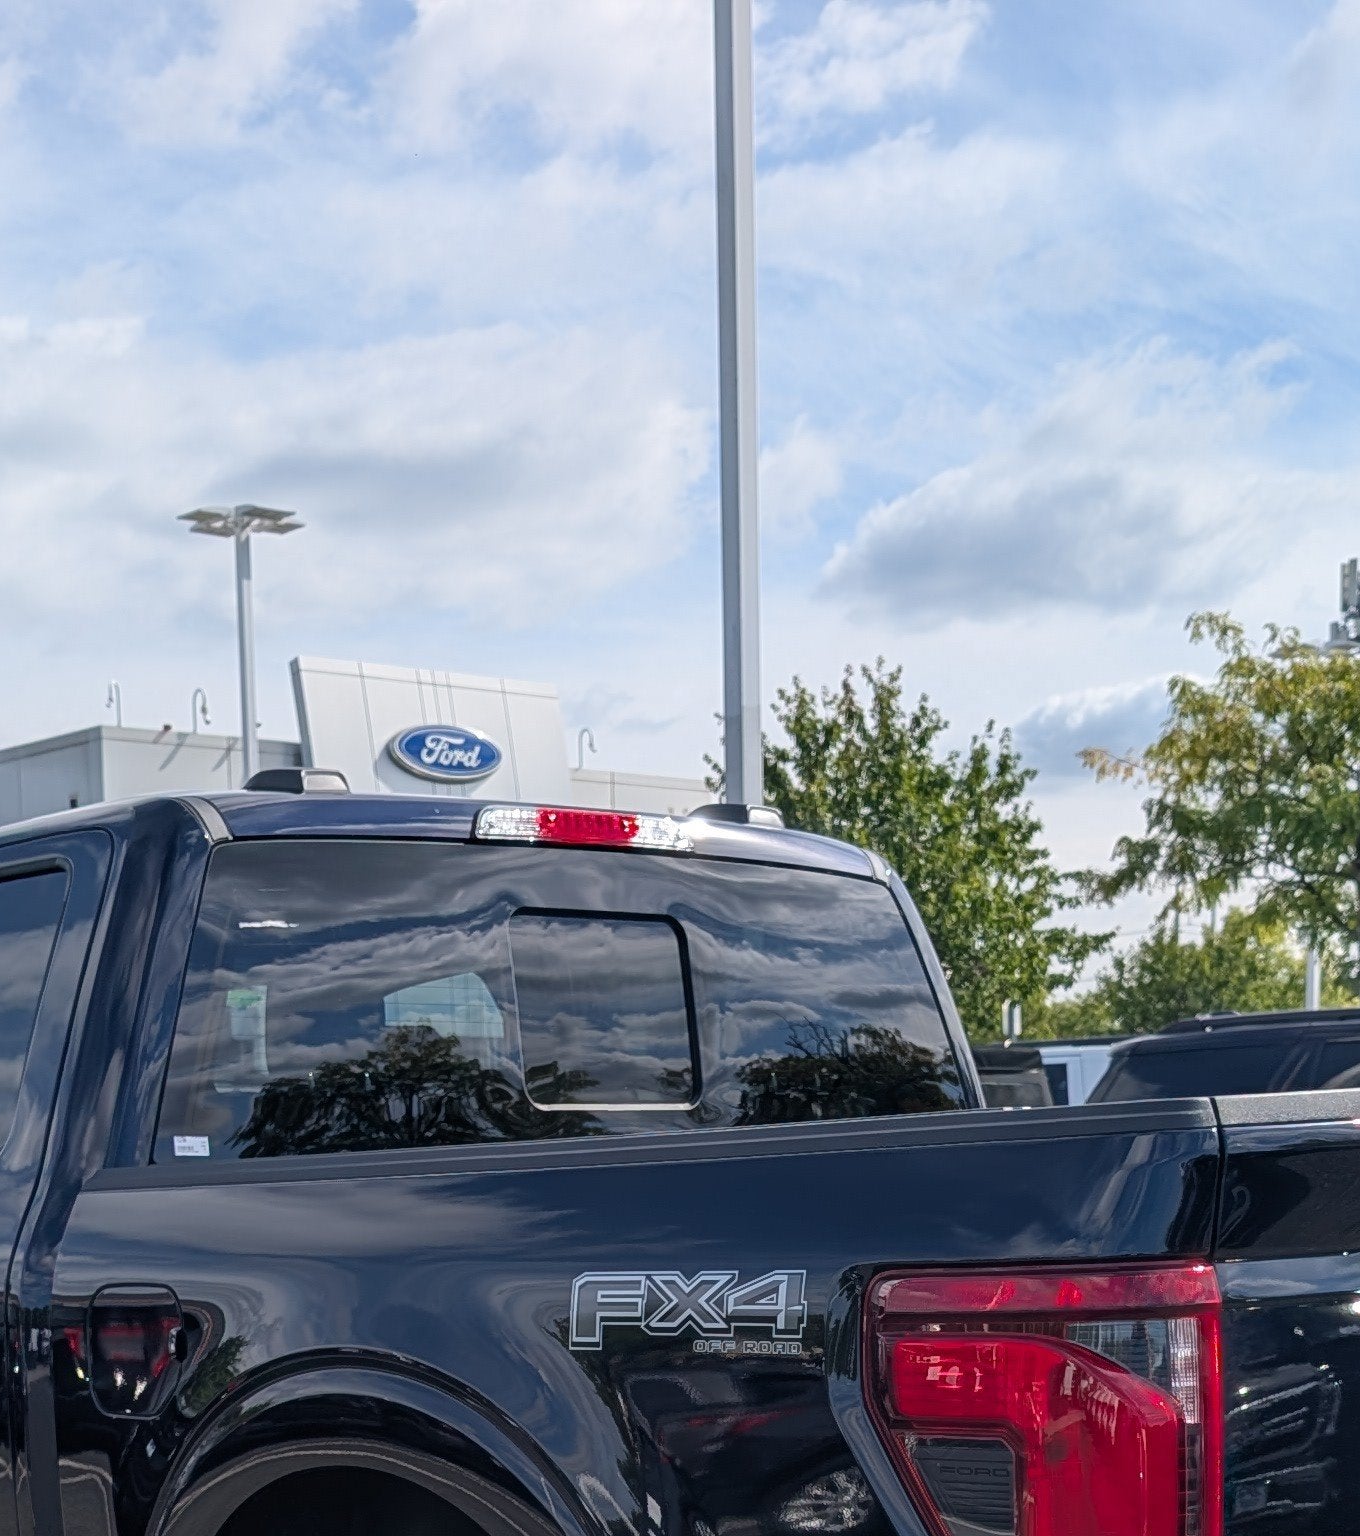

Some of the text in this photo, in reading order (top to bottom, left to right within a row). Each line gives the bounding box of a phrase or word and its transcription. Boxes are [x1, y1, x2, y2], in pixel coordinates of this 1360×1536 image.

[420, 735, 482, 768] Ford
[569, 1269, 808, 1351] FX4
[692, 1339, 803, 1356] OFF ROAD
[940, 1465, 1010, 1478] FORD
